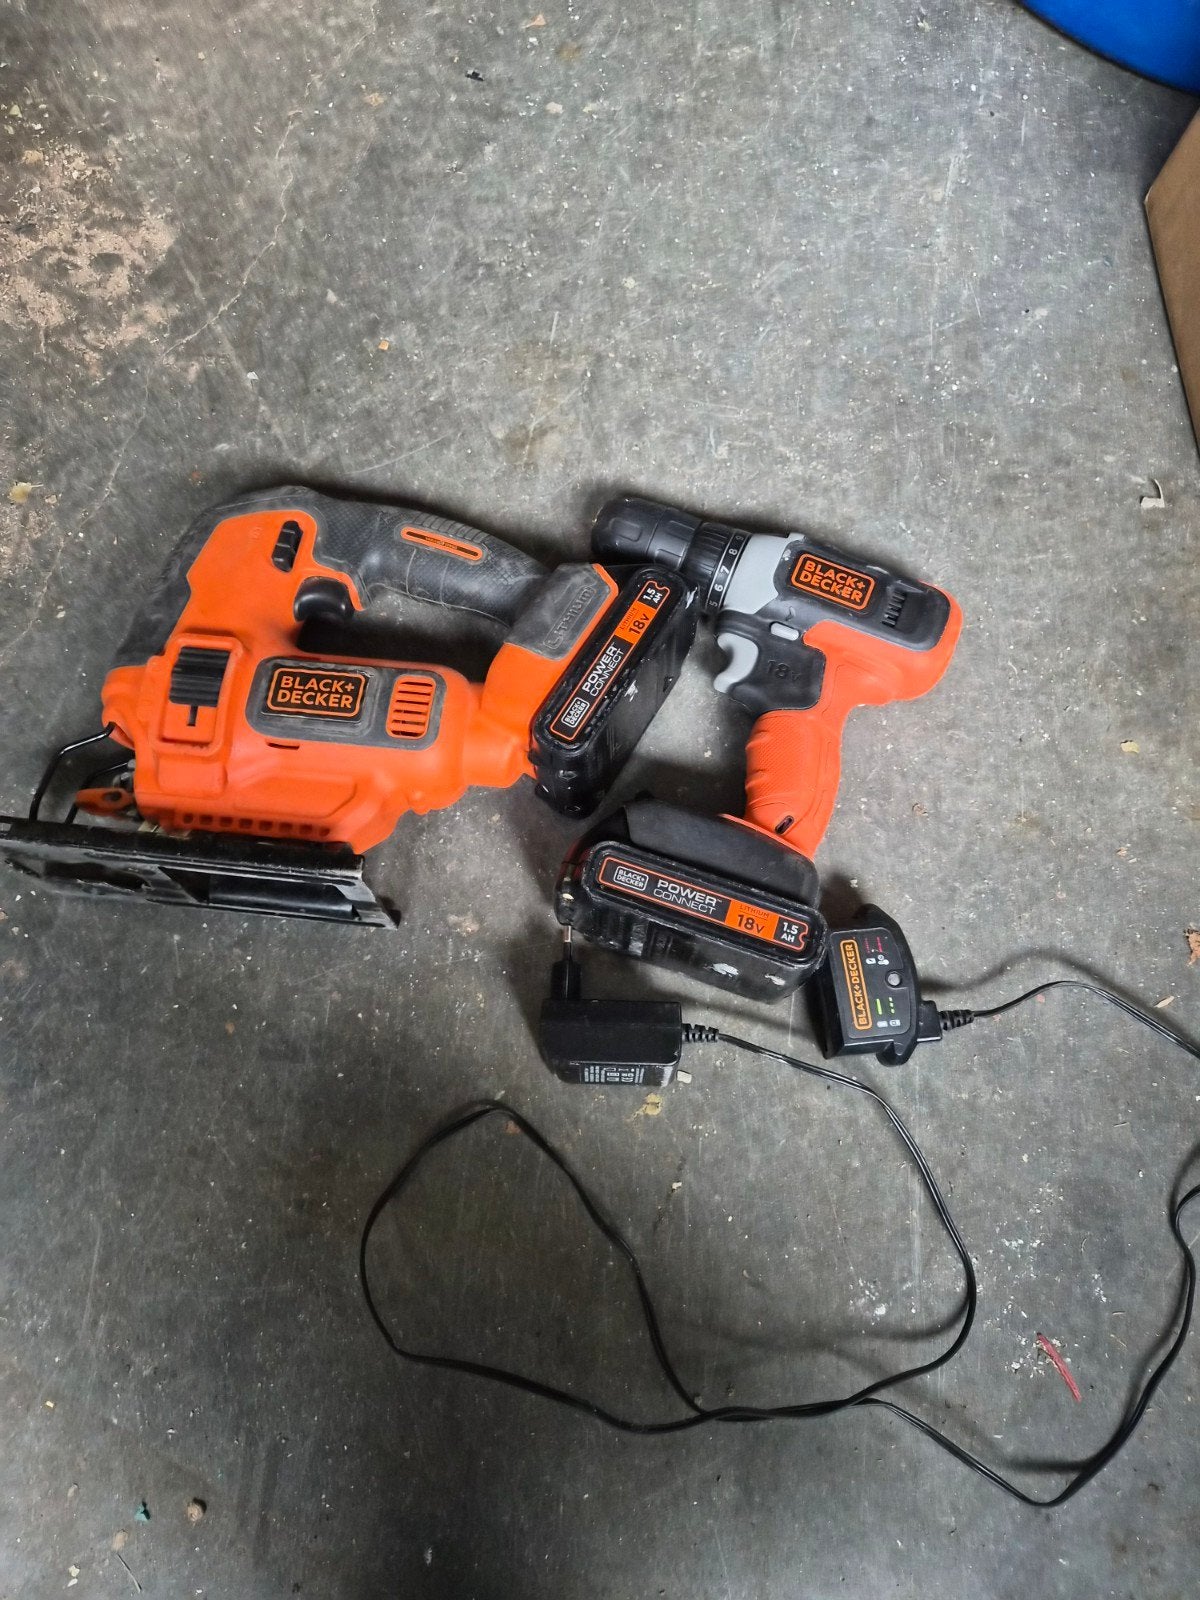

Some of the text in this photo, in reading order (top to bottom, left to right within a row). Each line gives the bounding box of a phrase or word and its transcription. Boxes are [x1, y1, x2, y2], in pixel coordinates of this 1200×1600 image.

[728, 548, 738, 556] 8
[720, 565, 730, 574] 7
[803, 560, 866, 590] BLACK+
[643, 587, 656, 600] 1.5
[714, 584, 724, 592] 6
[799, 570, 863, 604] DECKER
[653, 591, 663, 604] AH
[590, 648, 625, 697] CONNECT
[280, 675, 356, 693] BLACK+
[277, 689, 354, 709] DECKER
[564, 700, 581, 724] BLACK+
[569, 702, 587, 726] DECKER
[616, 874, 644, 888] DECKER
[618, 869, 645, 883] BLACK+
[653, 888, 716, 915] CONNECT
[739, 904, 770, 918] LITHIUM
[783, 921, 798, 935] 1.5
[780, 932, 795, 943] AH
[845, 943, 869, 1025] BLACK+DECKER
